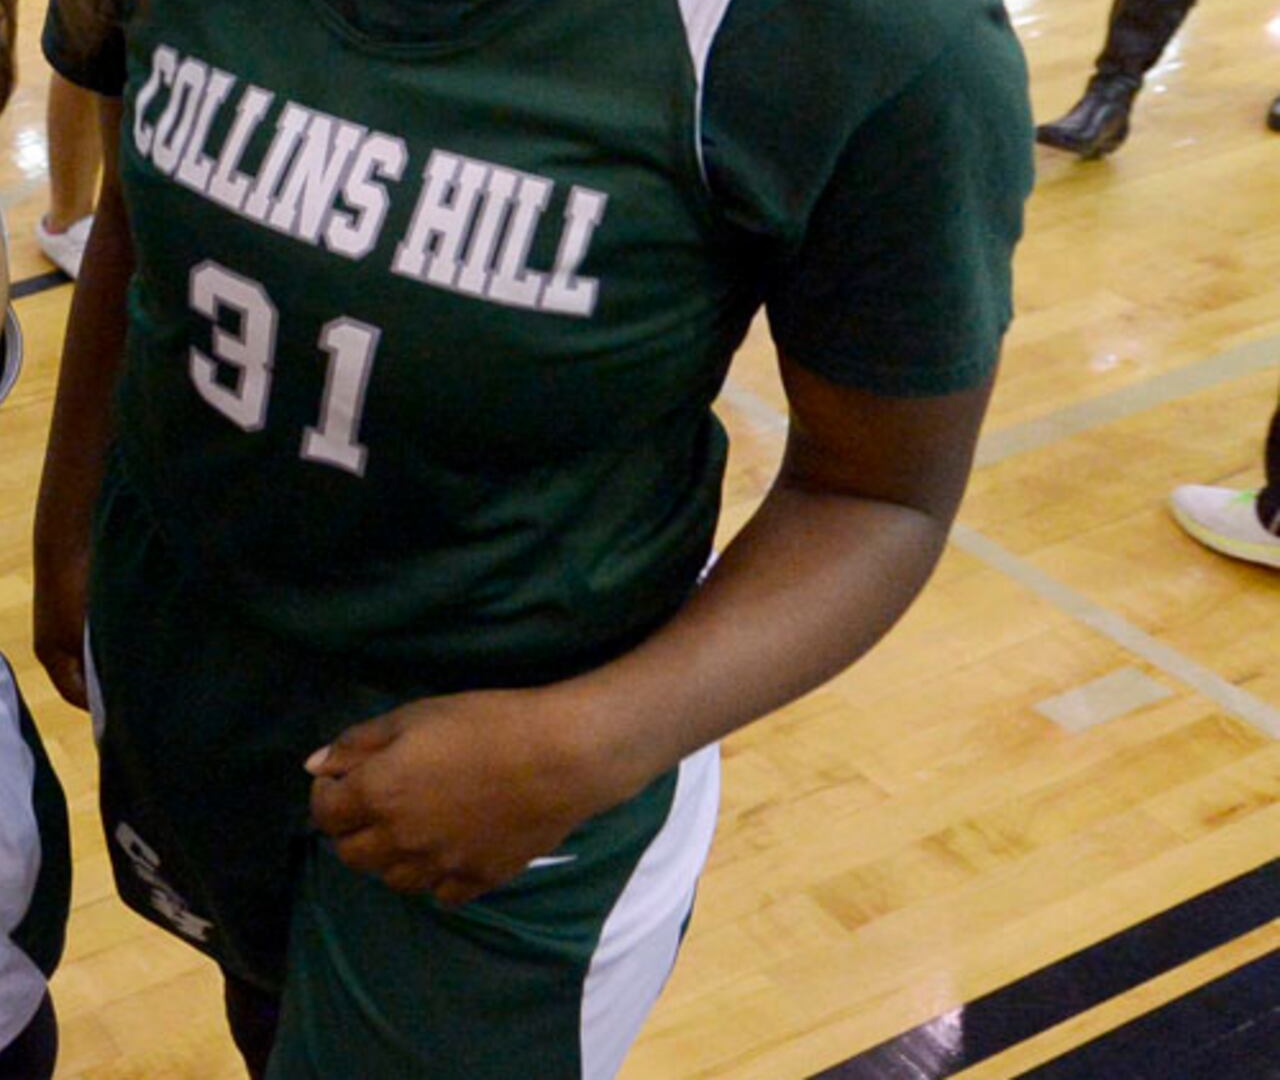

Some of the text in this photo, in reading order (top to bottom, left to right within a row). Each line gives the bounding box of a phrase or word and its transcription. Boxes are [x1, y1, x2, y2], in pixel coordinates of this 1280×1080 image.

[134, 43, 609, 318] COLLINS HILL
[187, 259, 382, 479] 31
